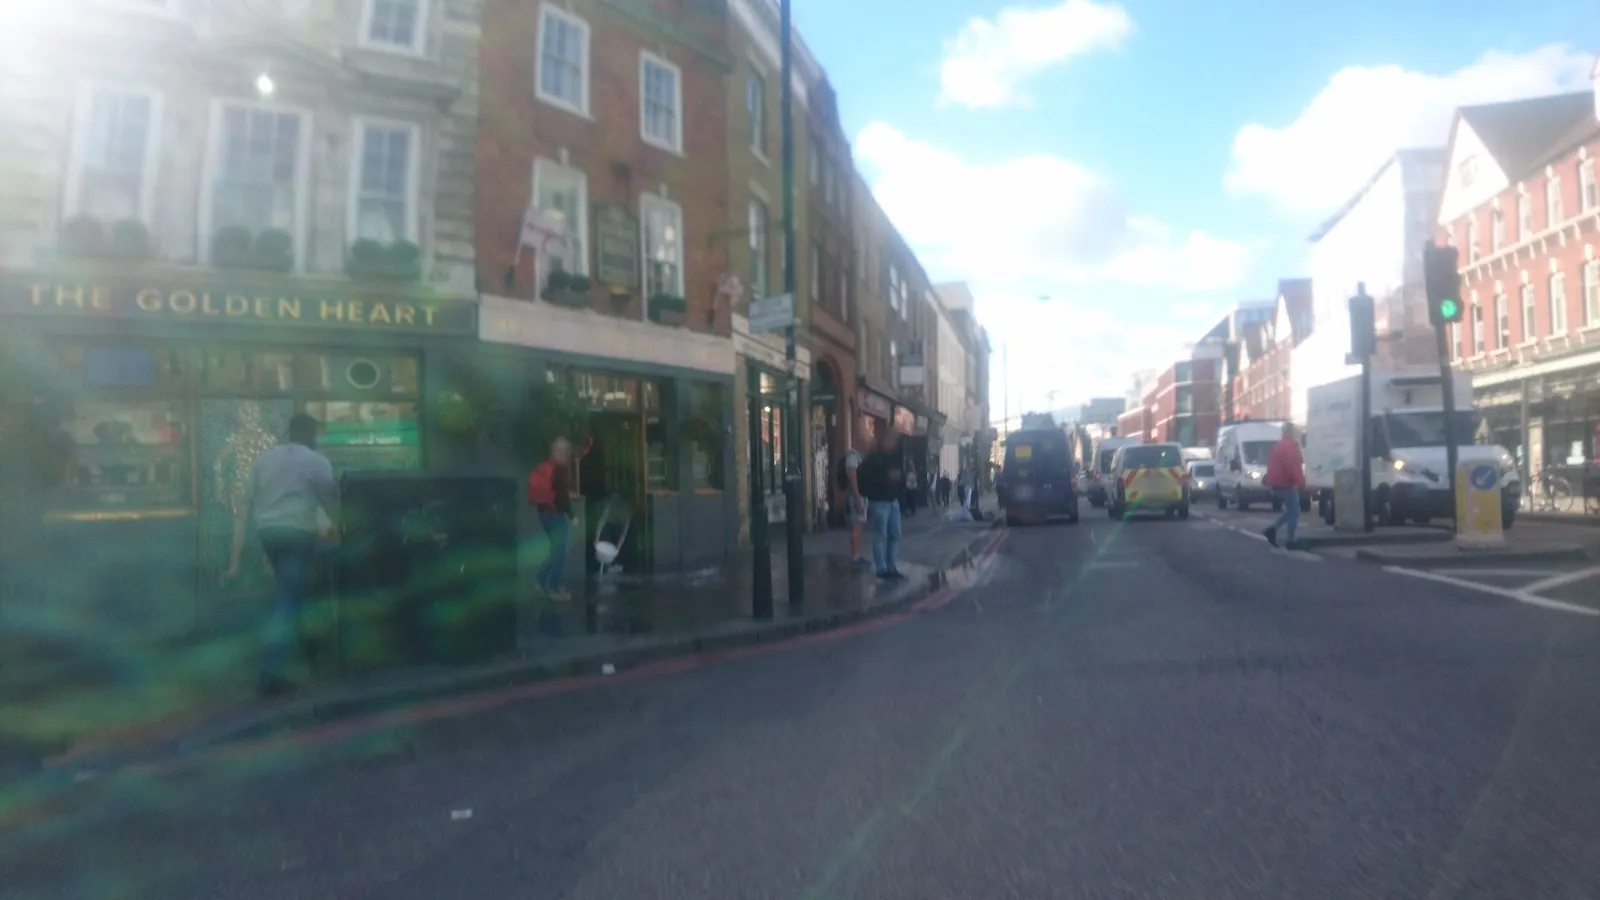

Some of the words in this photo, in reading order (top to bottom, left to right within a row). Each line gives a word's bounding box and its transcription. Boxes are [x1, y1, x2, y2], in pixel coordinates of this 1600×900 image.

[29, 284, 111, 310] THE
[136, 288, 301, 319] GOLDEN
[319, 300, 439, 326] HEART
